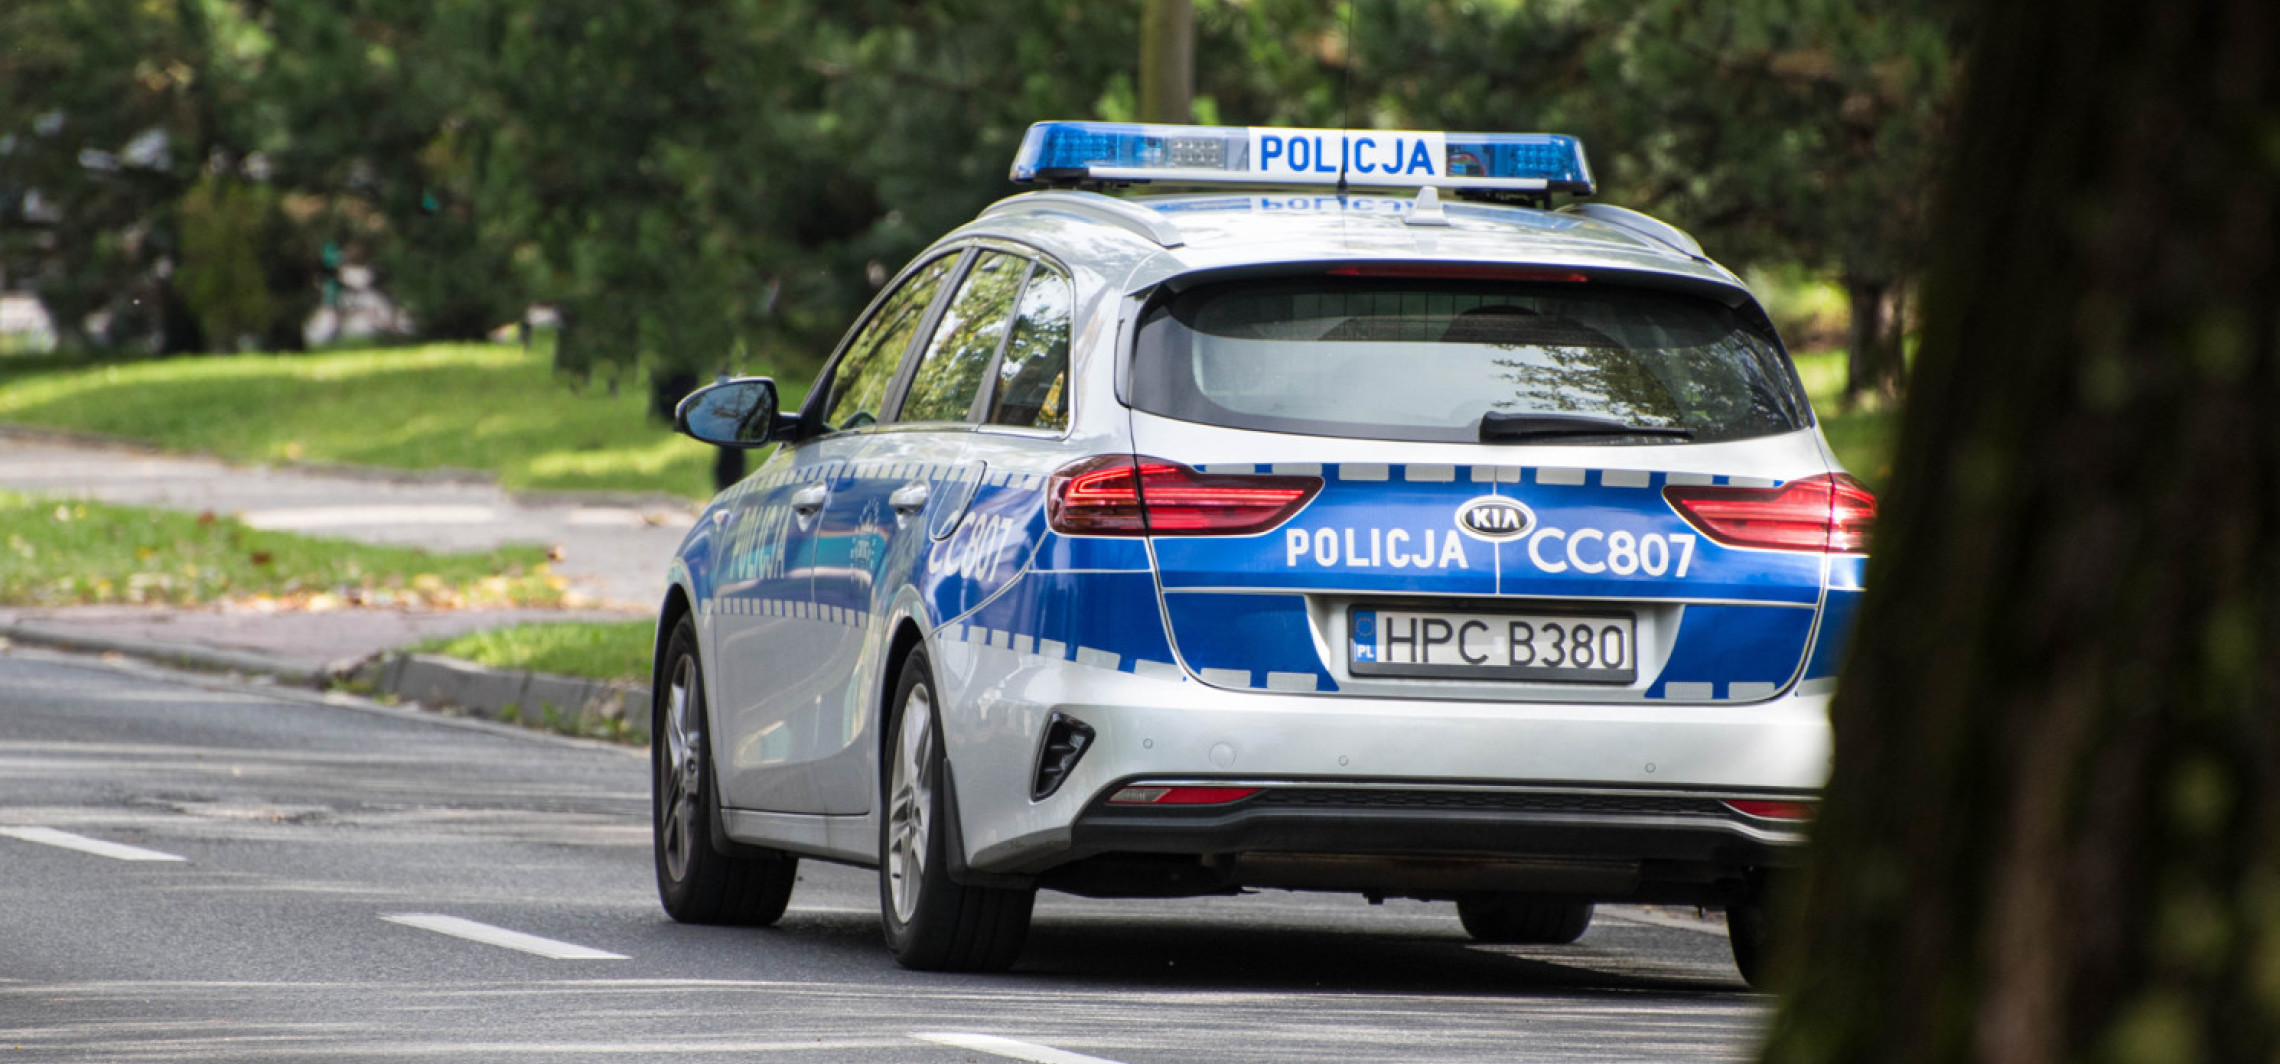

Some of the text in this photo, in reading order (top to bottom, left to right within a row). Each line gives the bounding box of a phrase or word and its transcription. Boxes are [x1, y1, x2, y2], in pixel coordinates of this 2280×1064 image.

[1260, 135, 1435, 175] POLICJA
[1472, 507, 1521, 529] KIA
[928, 510, 1014, 582] CC807
[1286, 527, 1469, 569] POLICJA
[1527, 527, 1696, 578] CC807
[1357, 645, 1375, 658] PL
[1385, 617, 1625, 669] HPC B380
